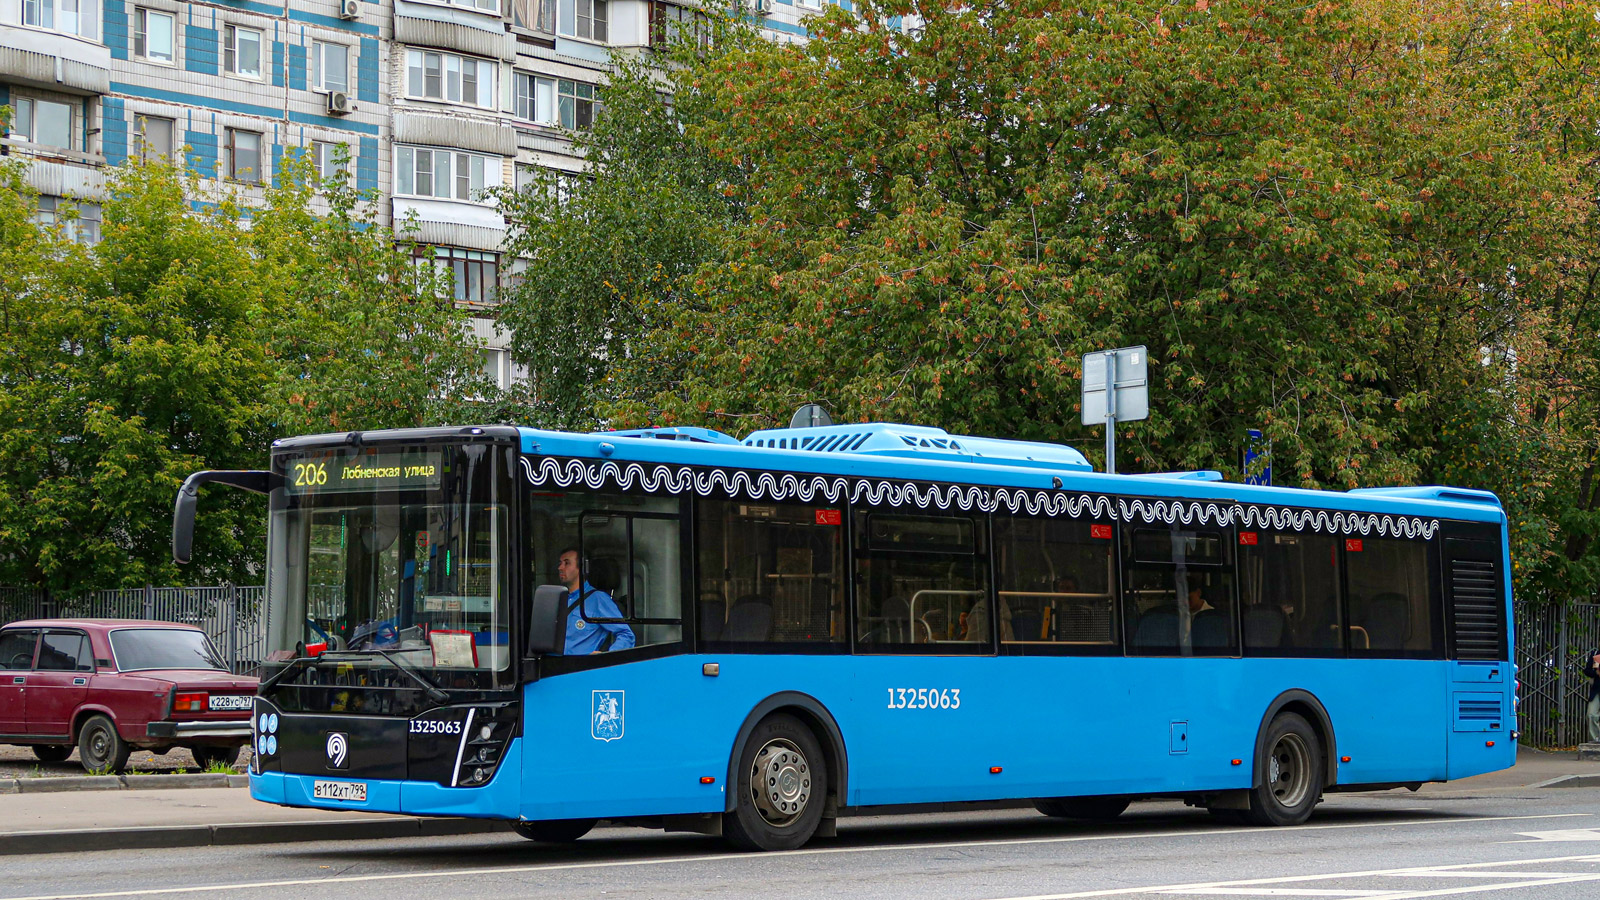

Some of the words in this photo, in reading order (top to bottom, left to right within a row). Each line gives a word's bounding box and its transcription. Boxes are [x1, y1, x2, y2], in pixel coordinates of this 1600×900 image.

[295, 463, 327, 486] 206
[341, 465, 400, 480] Лобненская
[404, 465, 435, 479] улица
[887, 688, 960, 709] 1325063
[410, 720, 461, 734] 1325063
